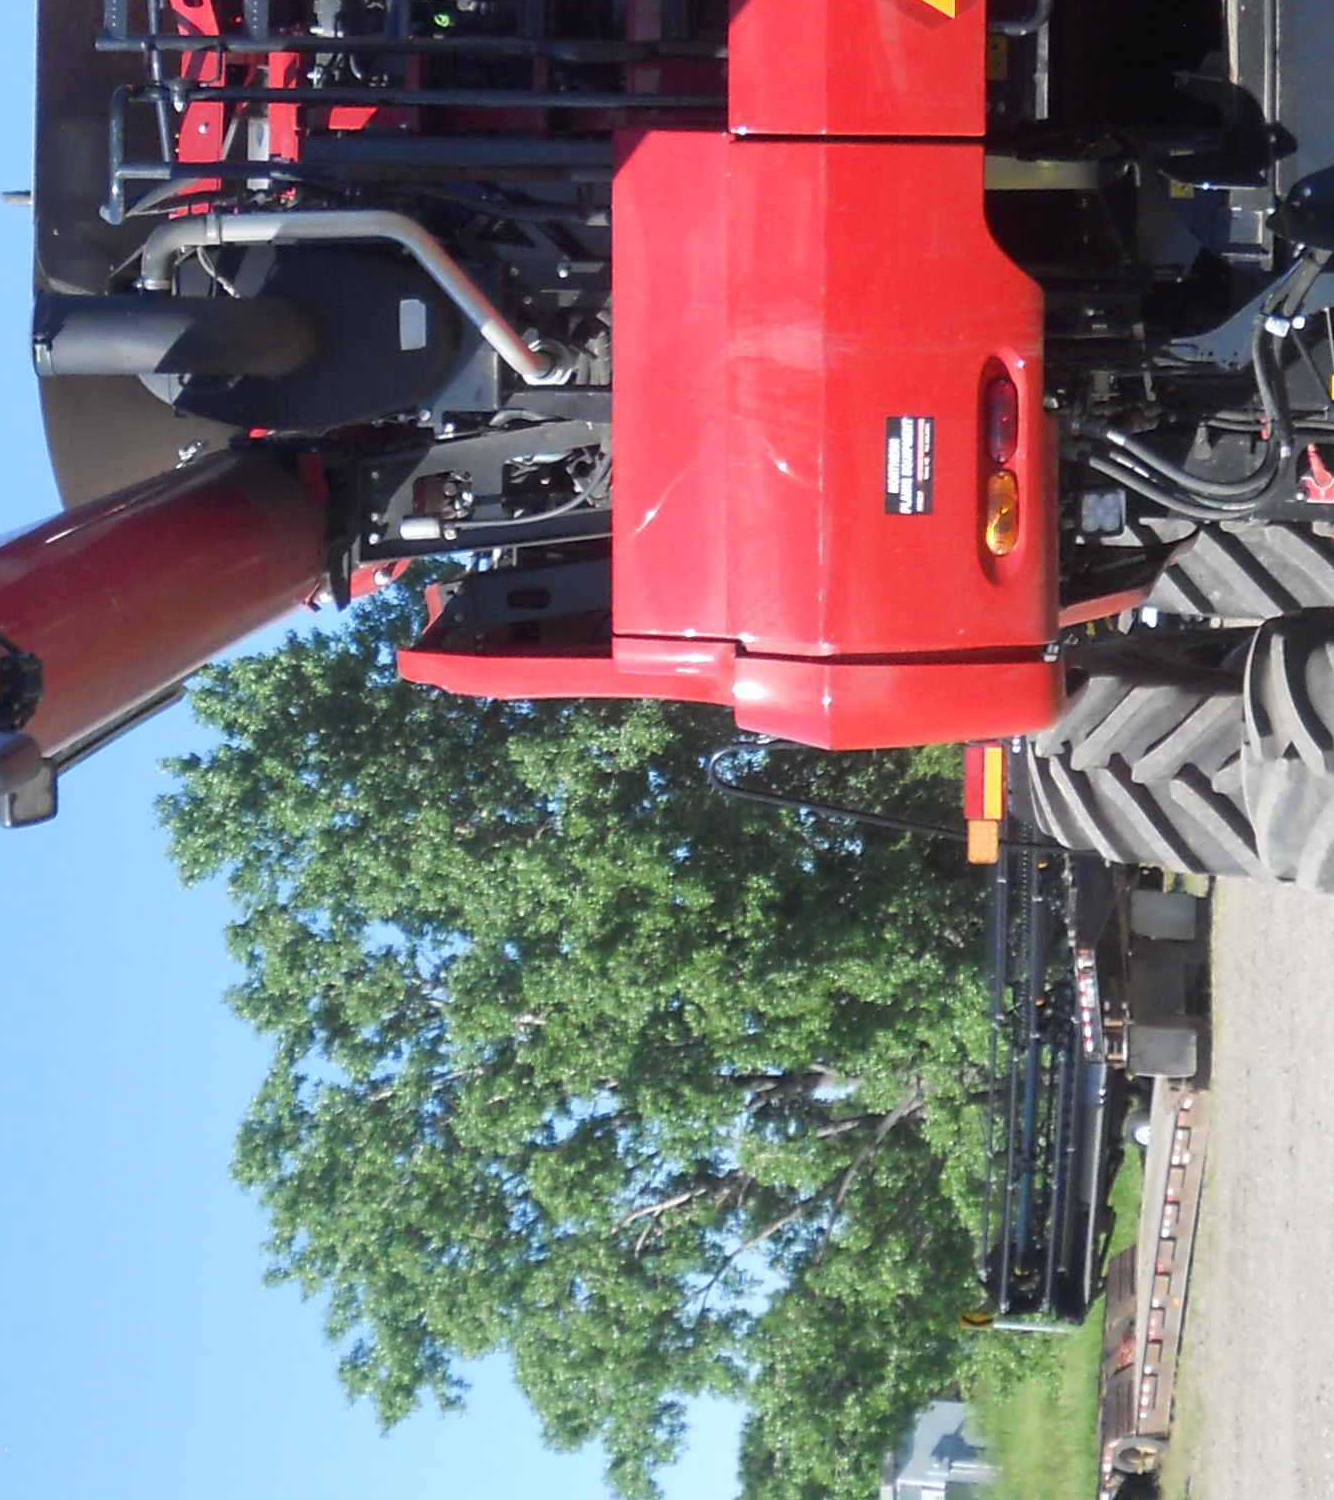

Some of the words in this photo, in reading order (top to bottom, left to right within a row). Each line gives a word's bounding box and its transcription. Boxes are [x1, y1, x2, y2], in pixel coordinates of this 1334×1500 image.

[887, 438, 900, 494] NORTHERN
[900, 417, 914, 477] EQUIPMENT
[899, 478, 913, 514] PLAINS
